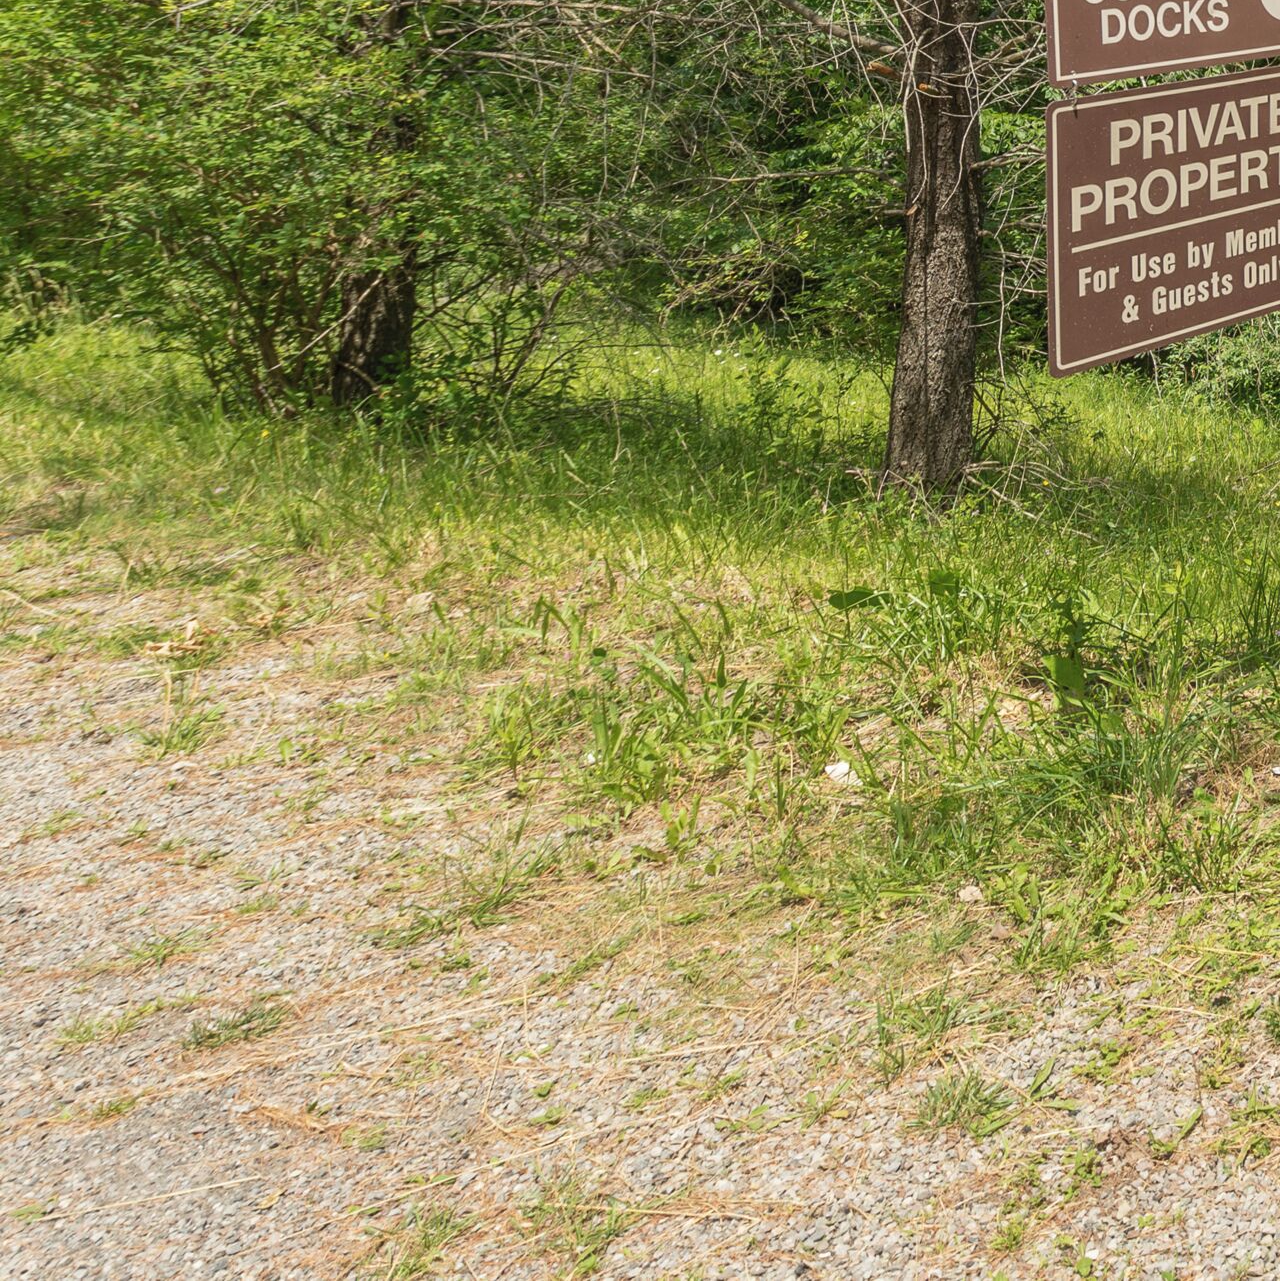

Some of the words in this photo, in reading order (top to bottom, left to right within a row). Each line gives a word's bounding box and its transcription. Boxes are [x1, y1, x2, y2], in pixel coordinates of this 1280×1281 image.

[1078, 265, 1120, 297] For
[1131, 252, 1176, 283] Use
[1187, 241, 1215, 268] by
[1121, 294, 1140, 323] &
[1152, 271, 1233, 315] Guests
